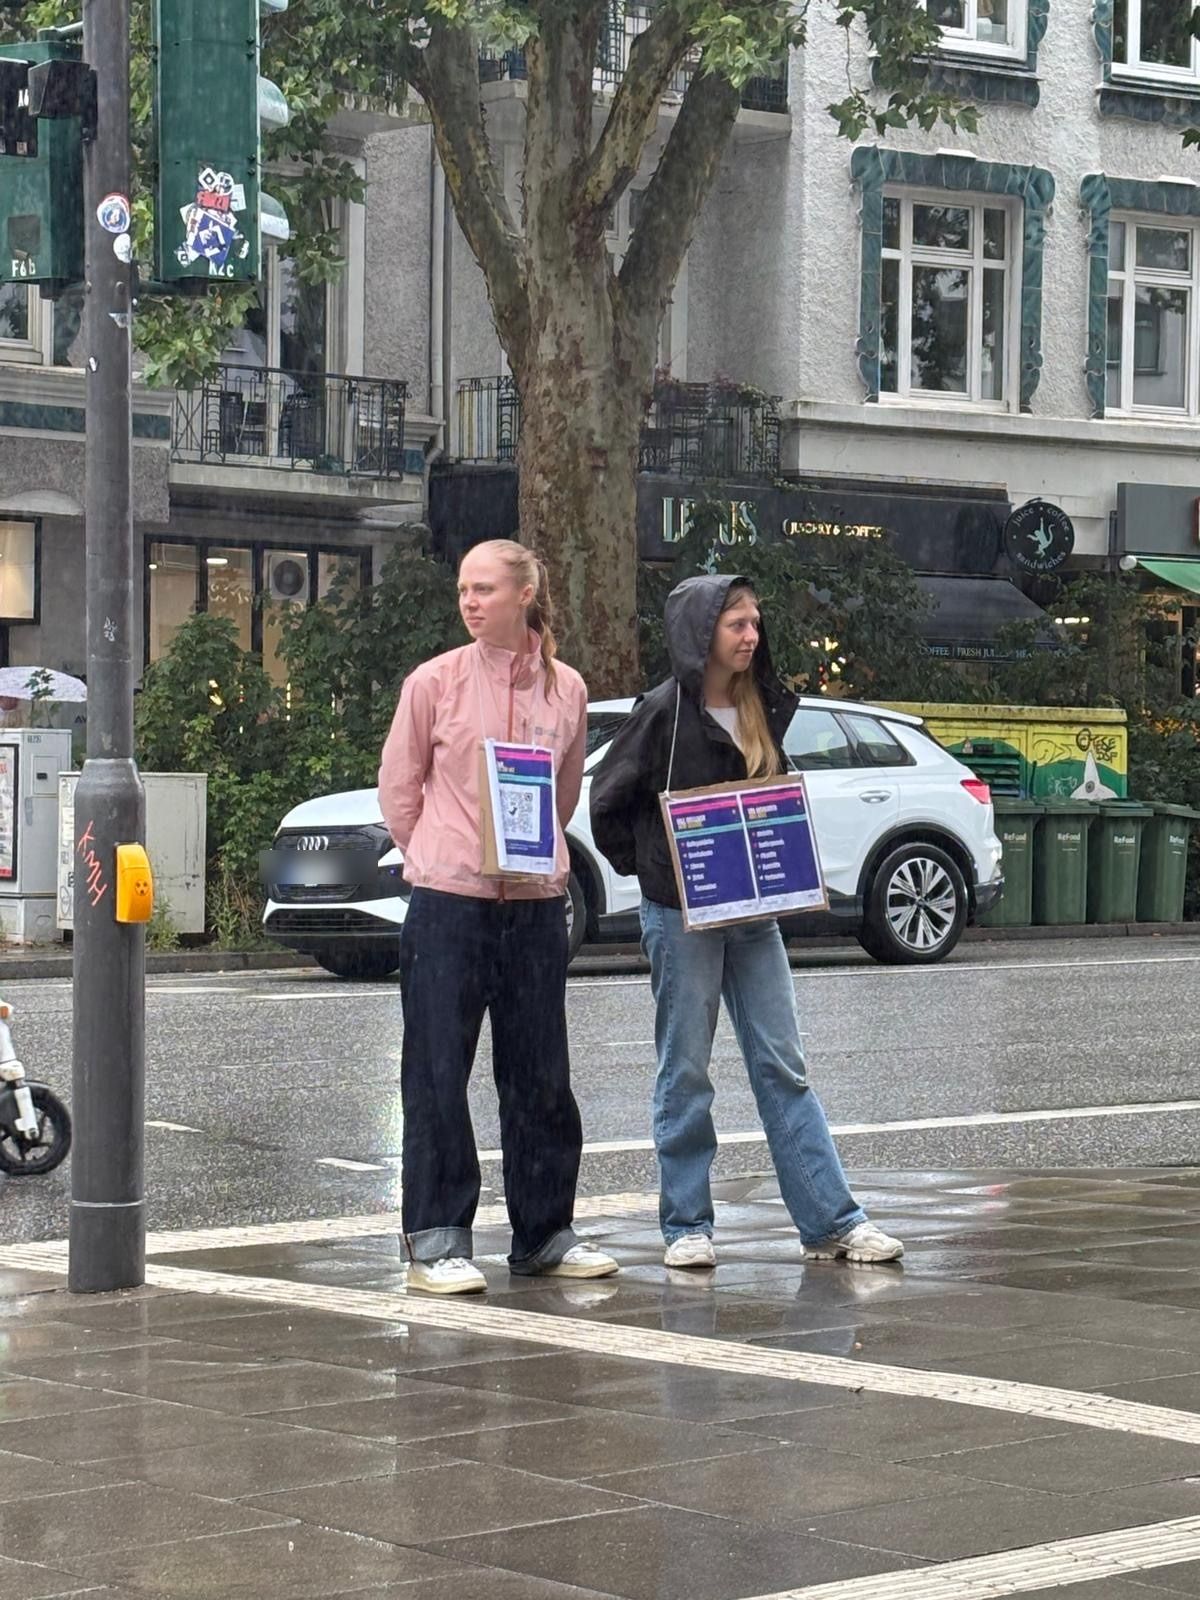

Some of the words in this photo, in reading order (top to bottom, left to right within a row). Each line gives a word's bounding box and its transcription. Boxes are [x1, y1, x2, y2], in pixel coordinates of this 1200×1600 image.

[662, 497, 757, 546] LEUS
[1012, 507, 1035, 528] juice
[1046, 507, 1070, 532] coffee
[1016, 552, 1066, 569] sandwiches
